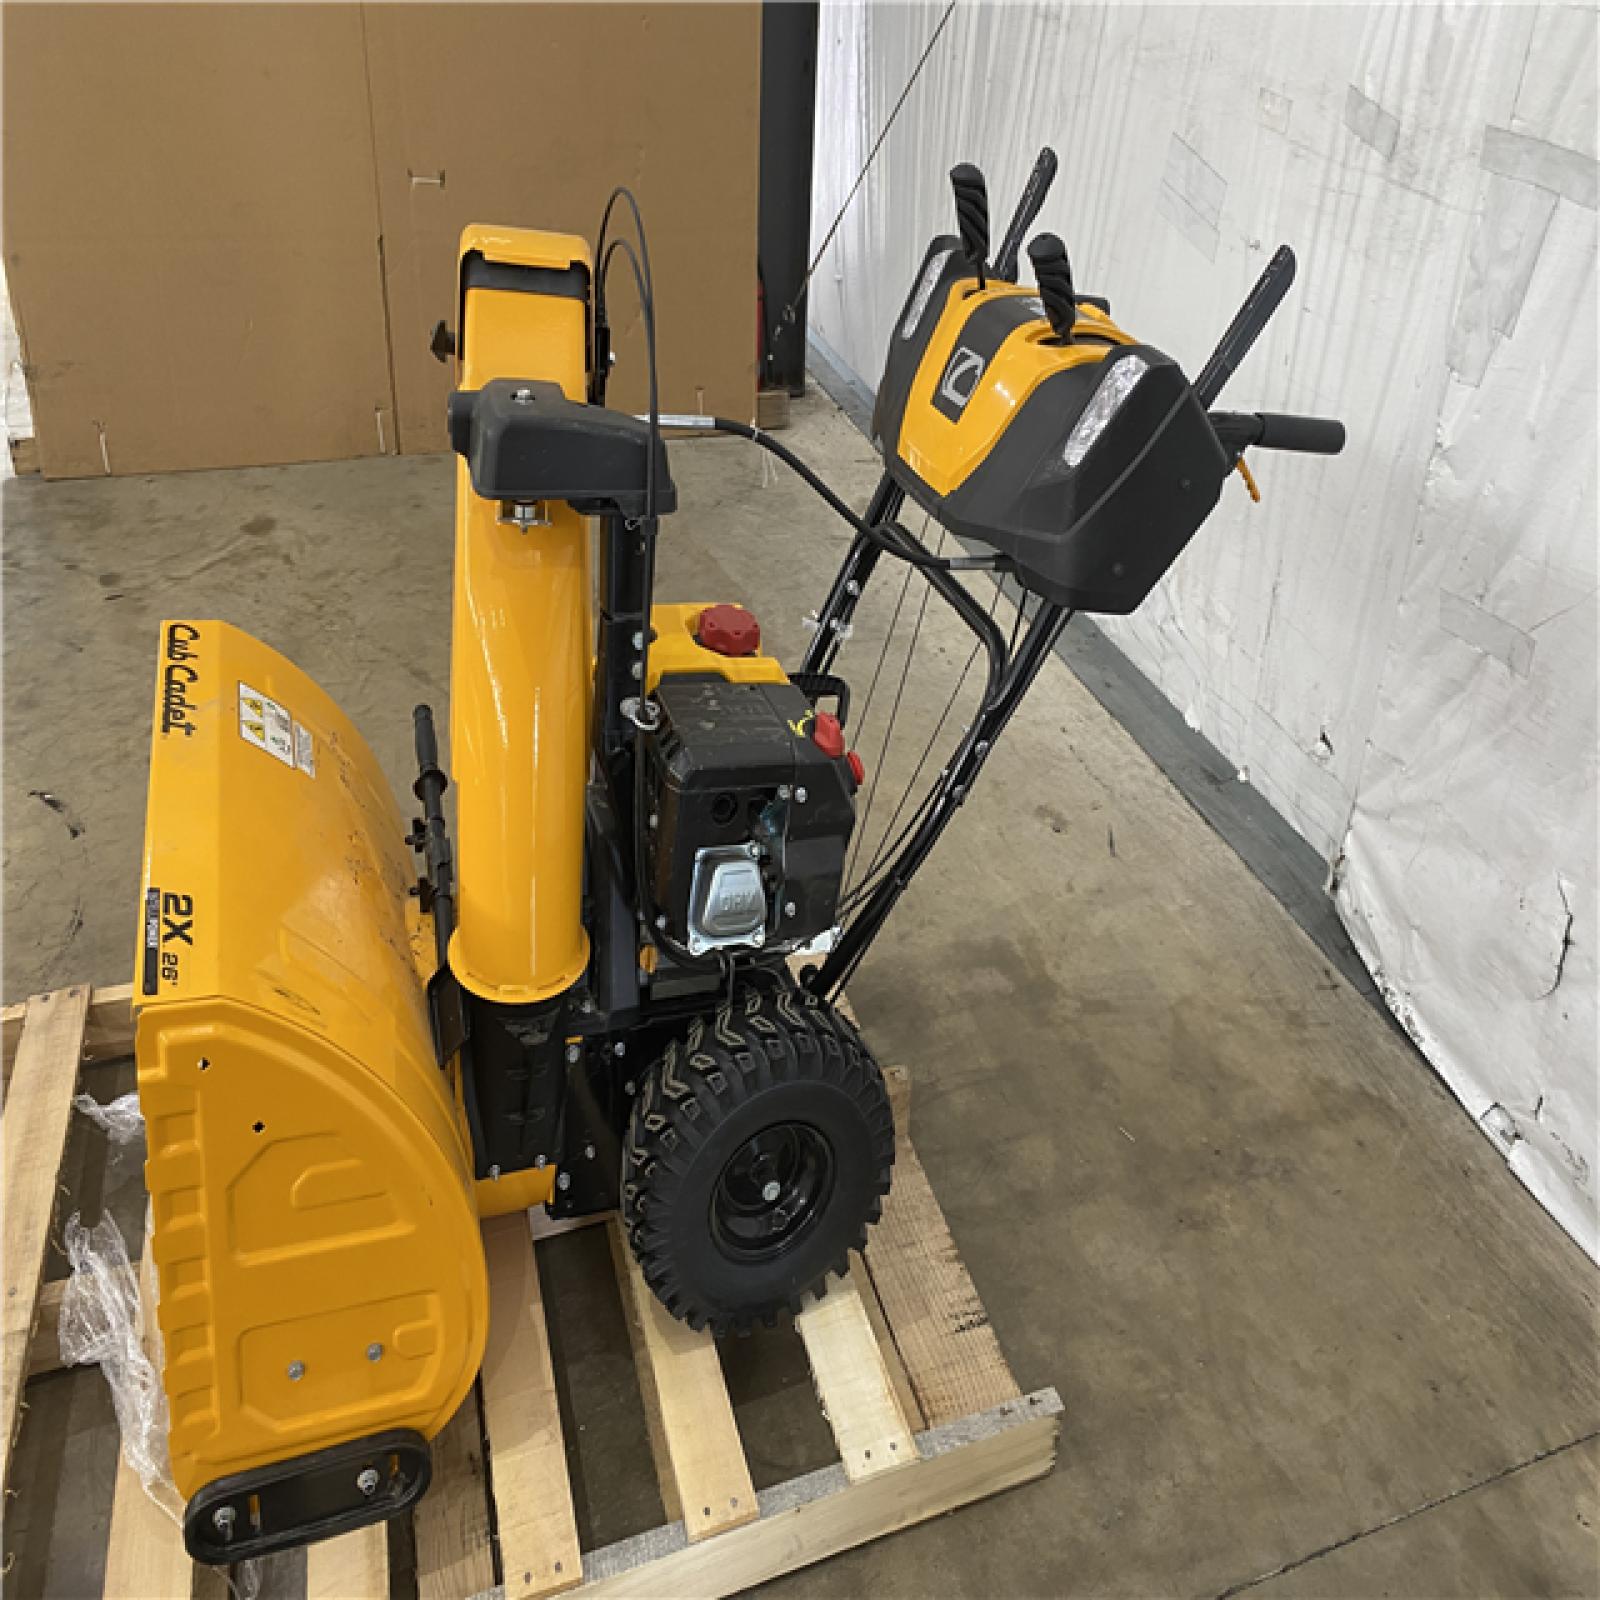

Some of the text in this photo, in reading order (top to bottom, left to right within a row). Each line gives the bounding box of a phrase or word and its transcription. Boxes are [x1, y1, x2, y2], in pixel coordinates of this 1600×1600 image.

[162, 624, 200, 736] Cub Cadet
[162, 892, 193, 946] 2X
